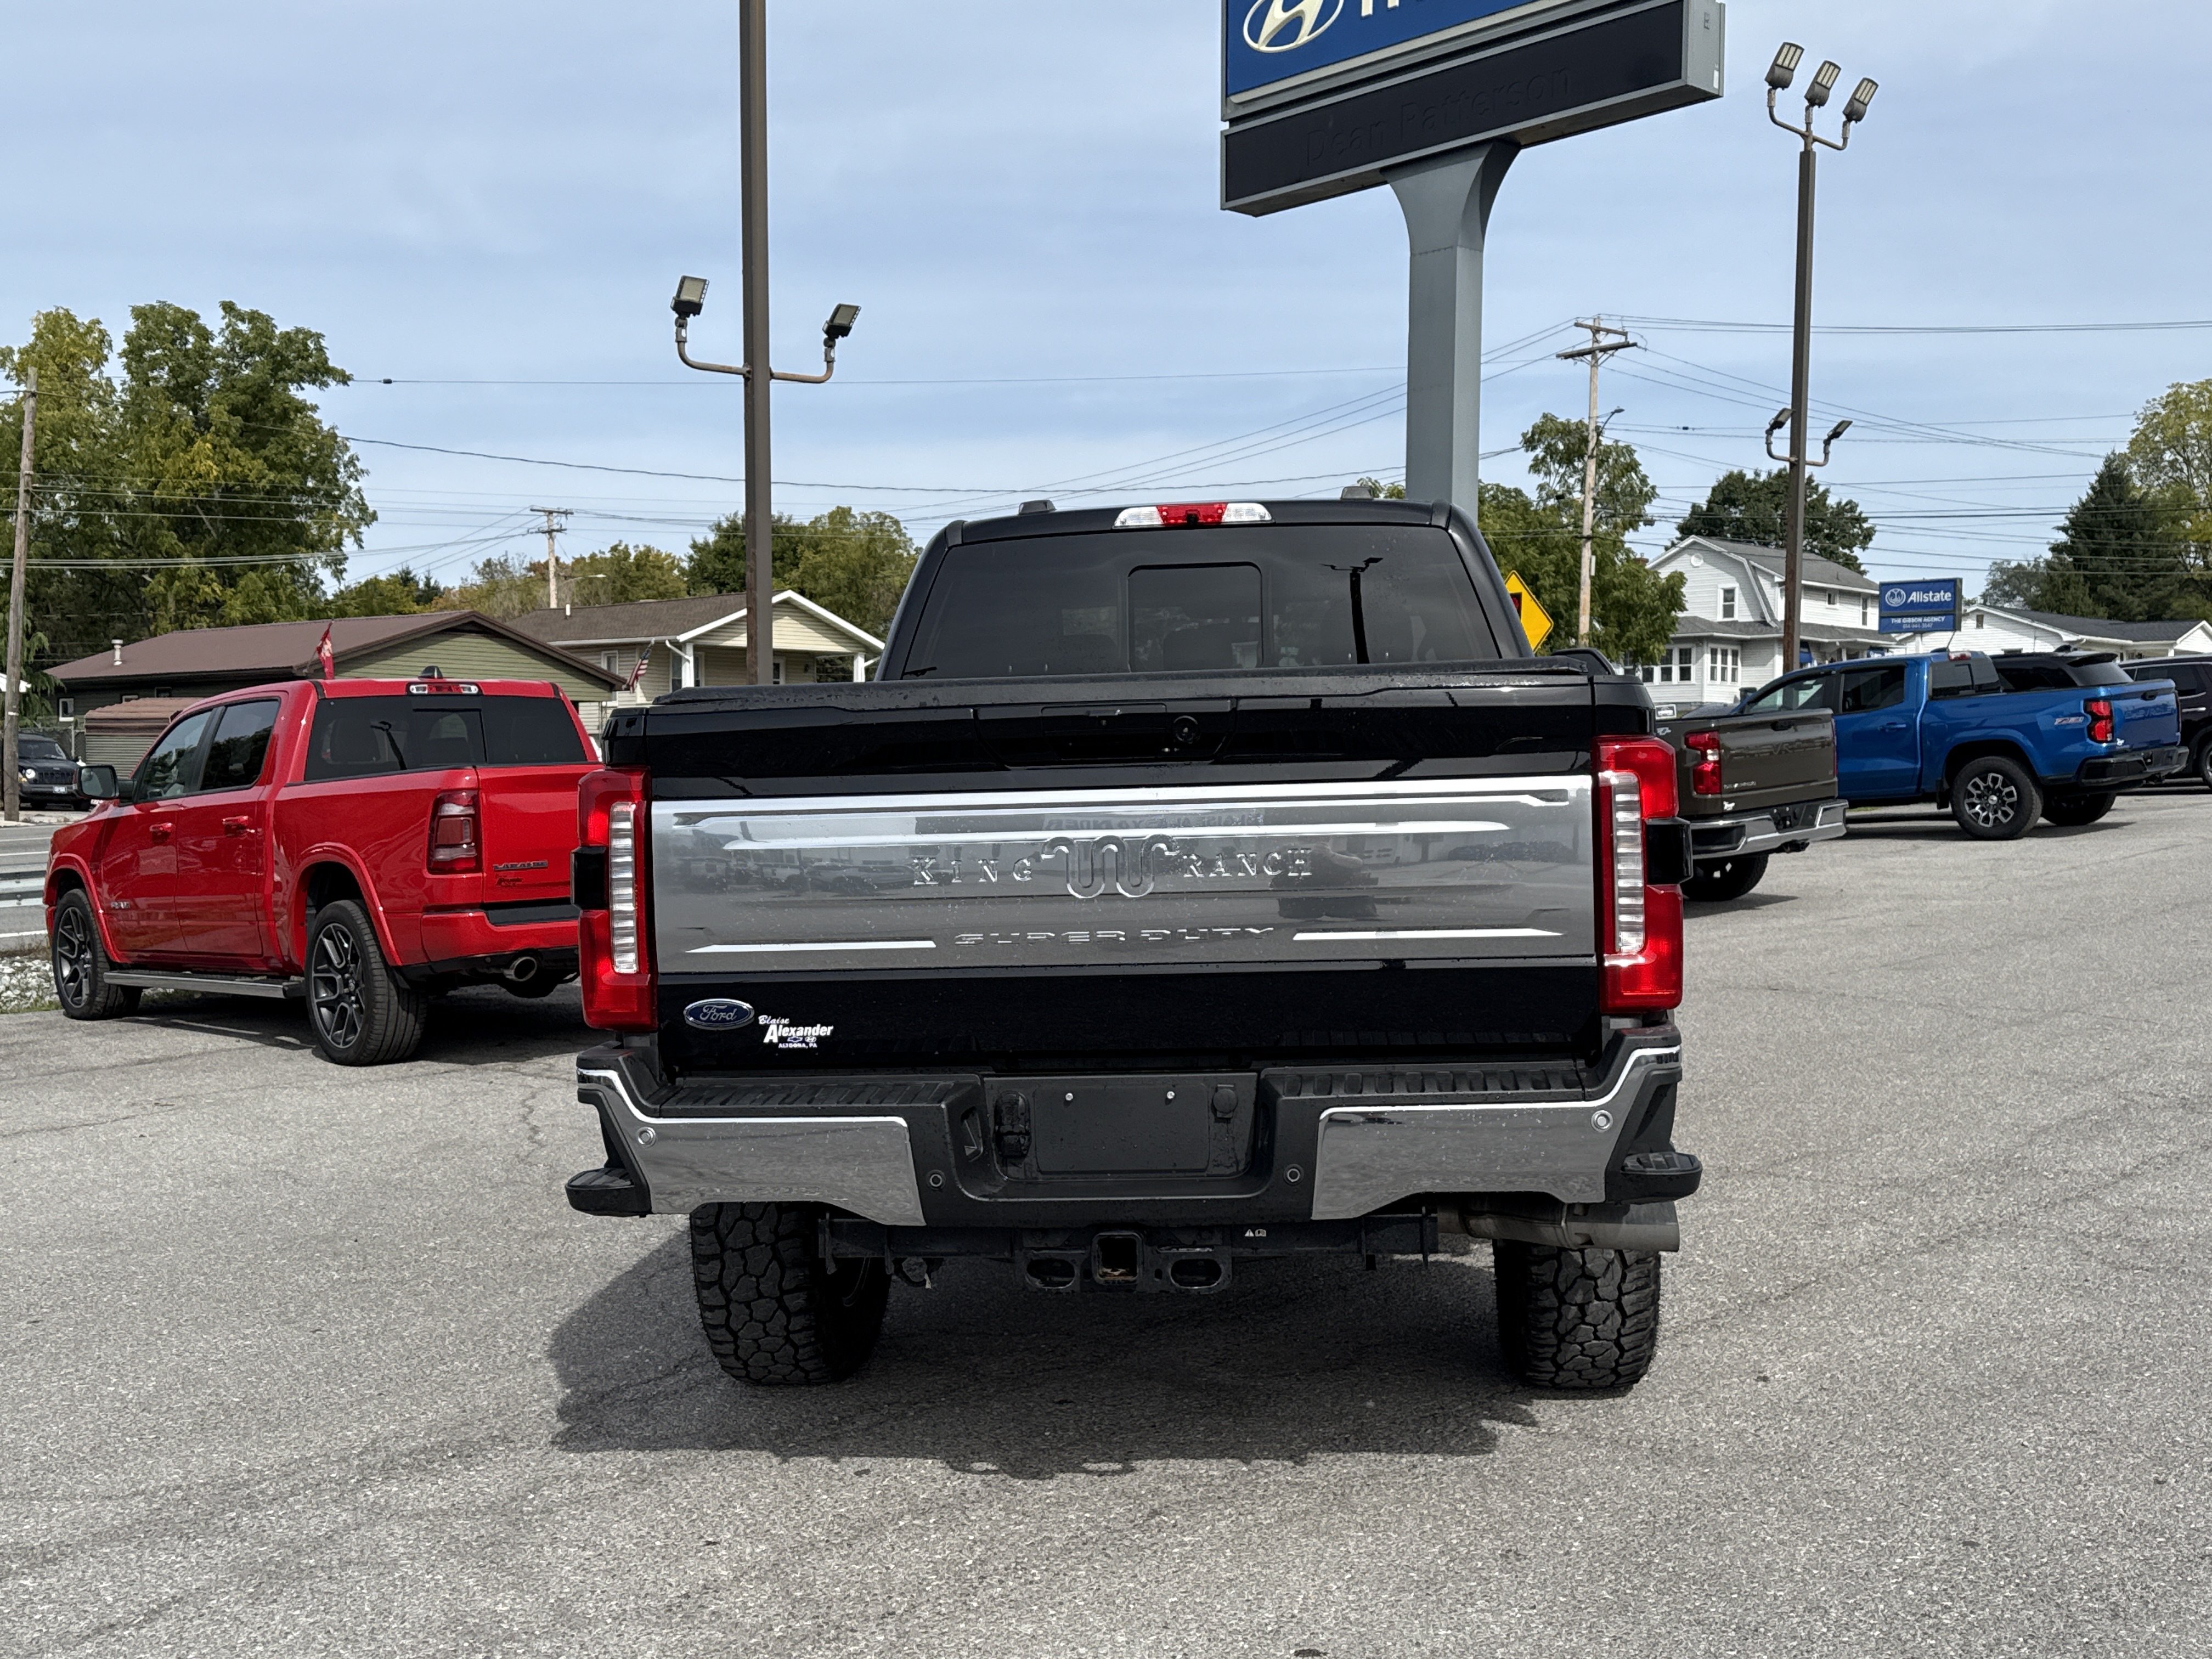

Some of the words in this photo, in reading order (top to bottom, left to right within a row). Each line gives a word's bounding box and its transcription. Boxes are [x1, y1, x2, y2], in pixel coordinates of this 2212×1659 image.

[1307, 117, 1385, 166] Dean
[1399, 66, 1572, 143] Patterson
[1907, 590, 1952, 603] Allstate
[913, 856, 1034, 885] KING
[1182, 848, 1313, 878] RANCH
[954, 929, 1126, 946] SUPER
[1139, 927, 1275, 944] DUTY
[699, 1005, 737, 1021] Ford
[758, 1015, 790, 1025] Blaise
[763, 1024, 834, 1043] Alexander
